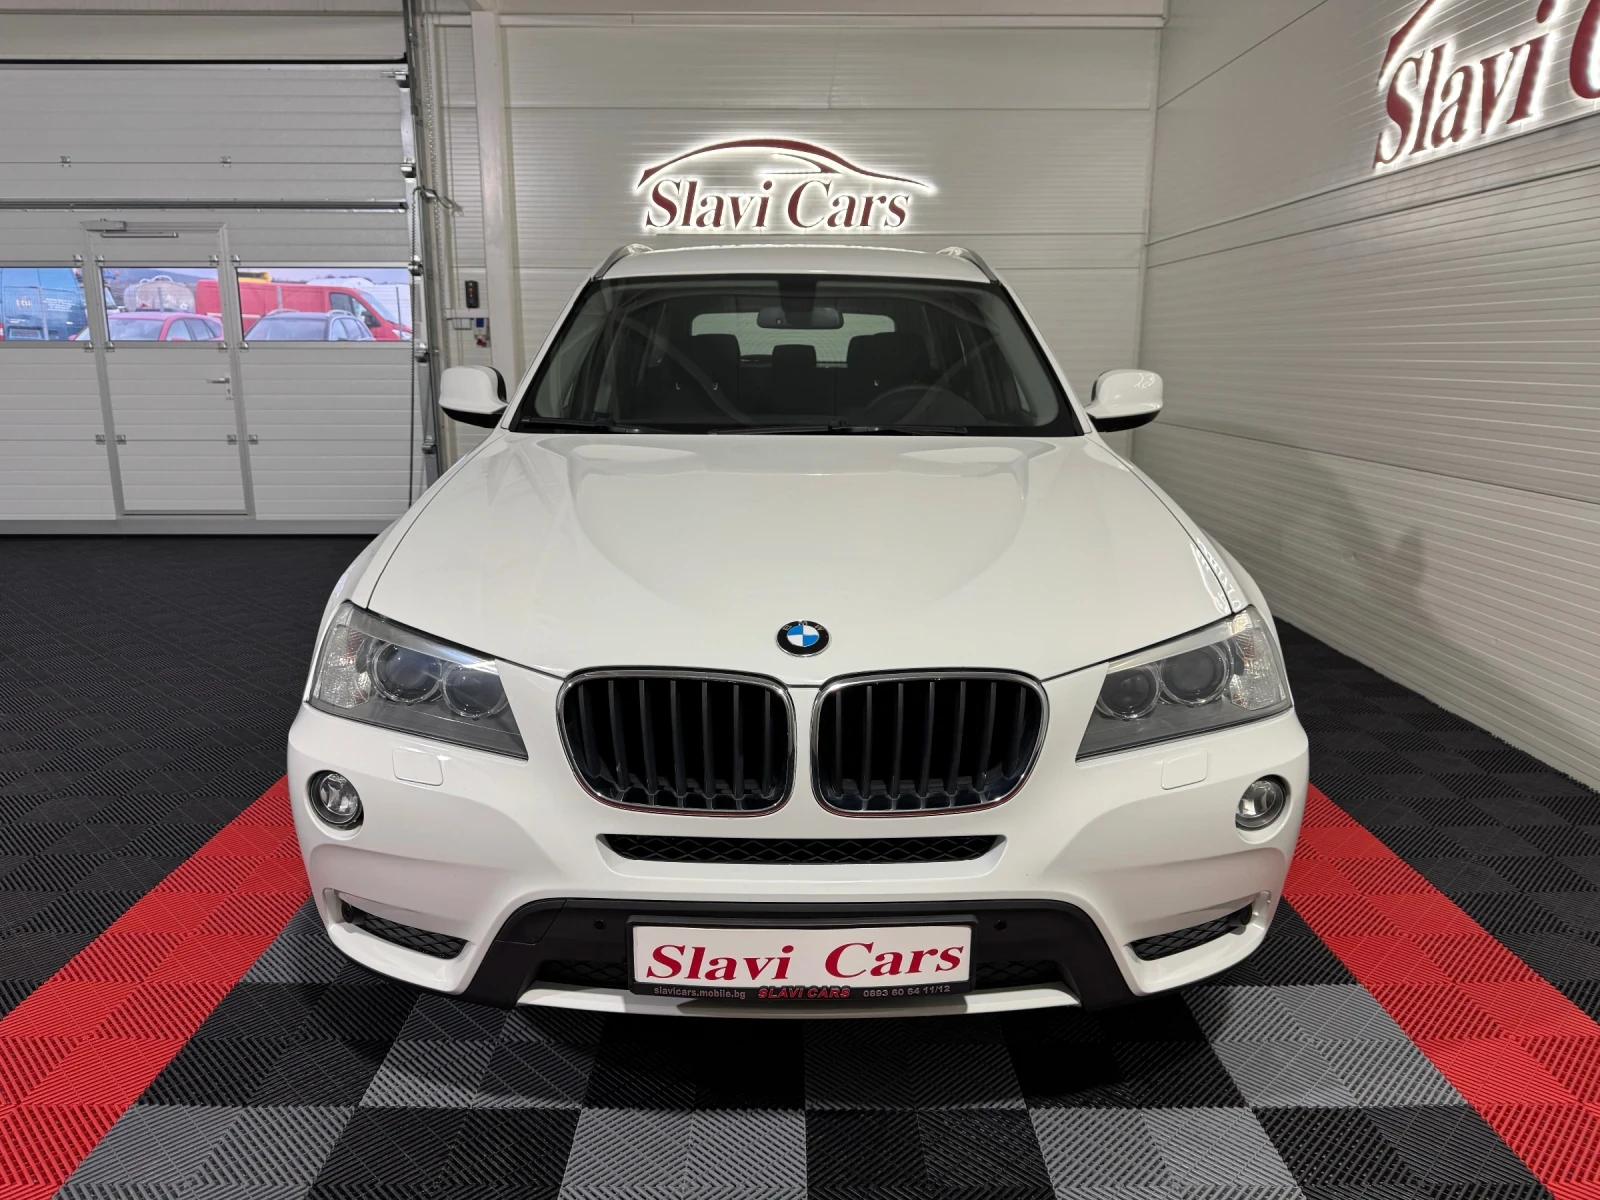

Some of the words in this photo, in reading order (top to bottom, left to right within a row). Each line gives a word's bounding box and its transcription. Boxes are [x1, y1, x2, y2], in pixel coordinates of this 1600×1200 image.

[1372, 0, 1556, 169] Slavi
[646, 179, 773, 228] Slavi
[787, 179, 910, 228] Cars
[646, 944, 795, 981] Slavi
[824, 941, 965, 979] Cars
[654, 986, 746, 1000] slavicars.mobile.bg
[757, 986, 804, 999] SLAVI
[806, 986, 851, 999] CARS
[863, 989, 889, 998] 0893
[891, 988, 905, 996] 60
[907, 987, 920, 996] 64
[923, 985, 951, 994] 11/12
